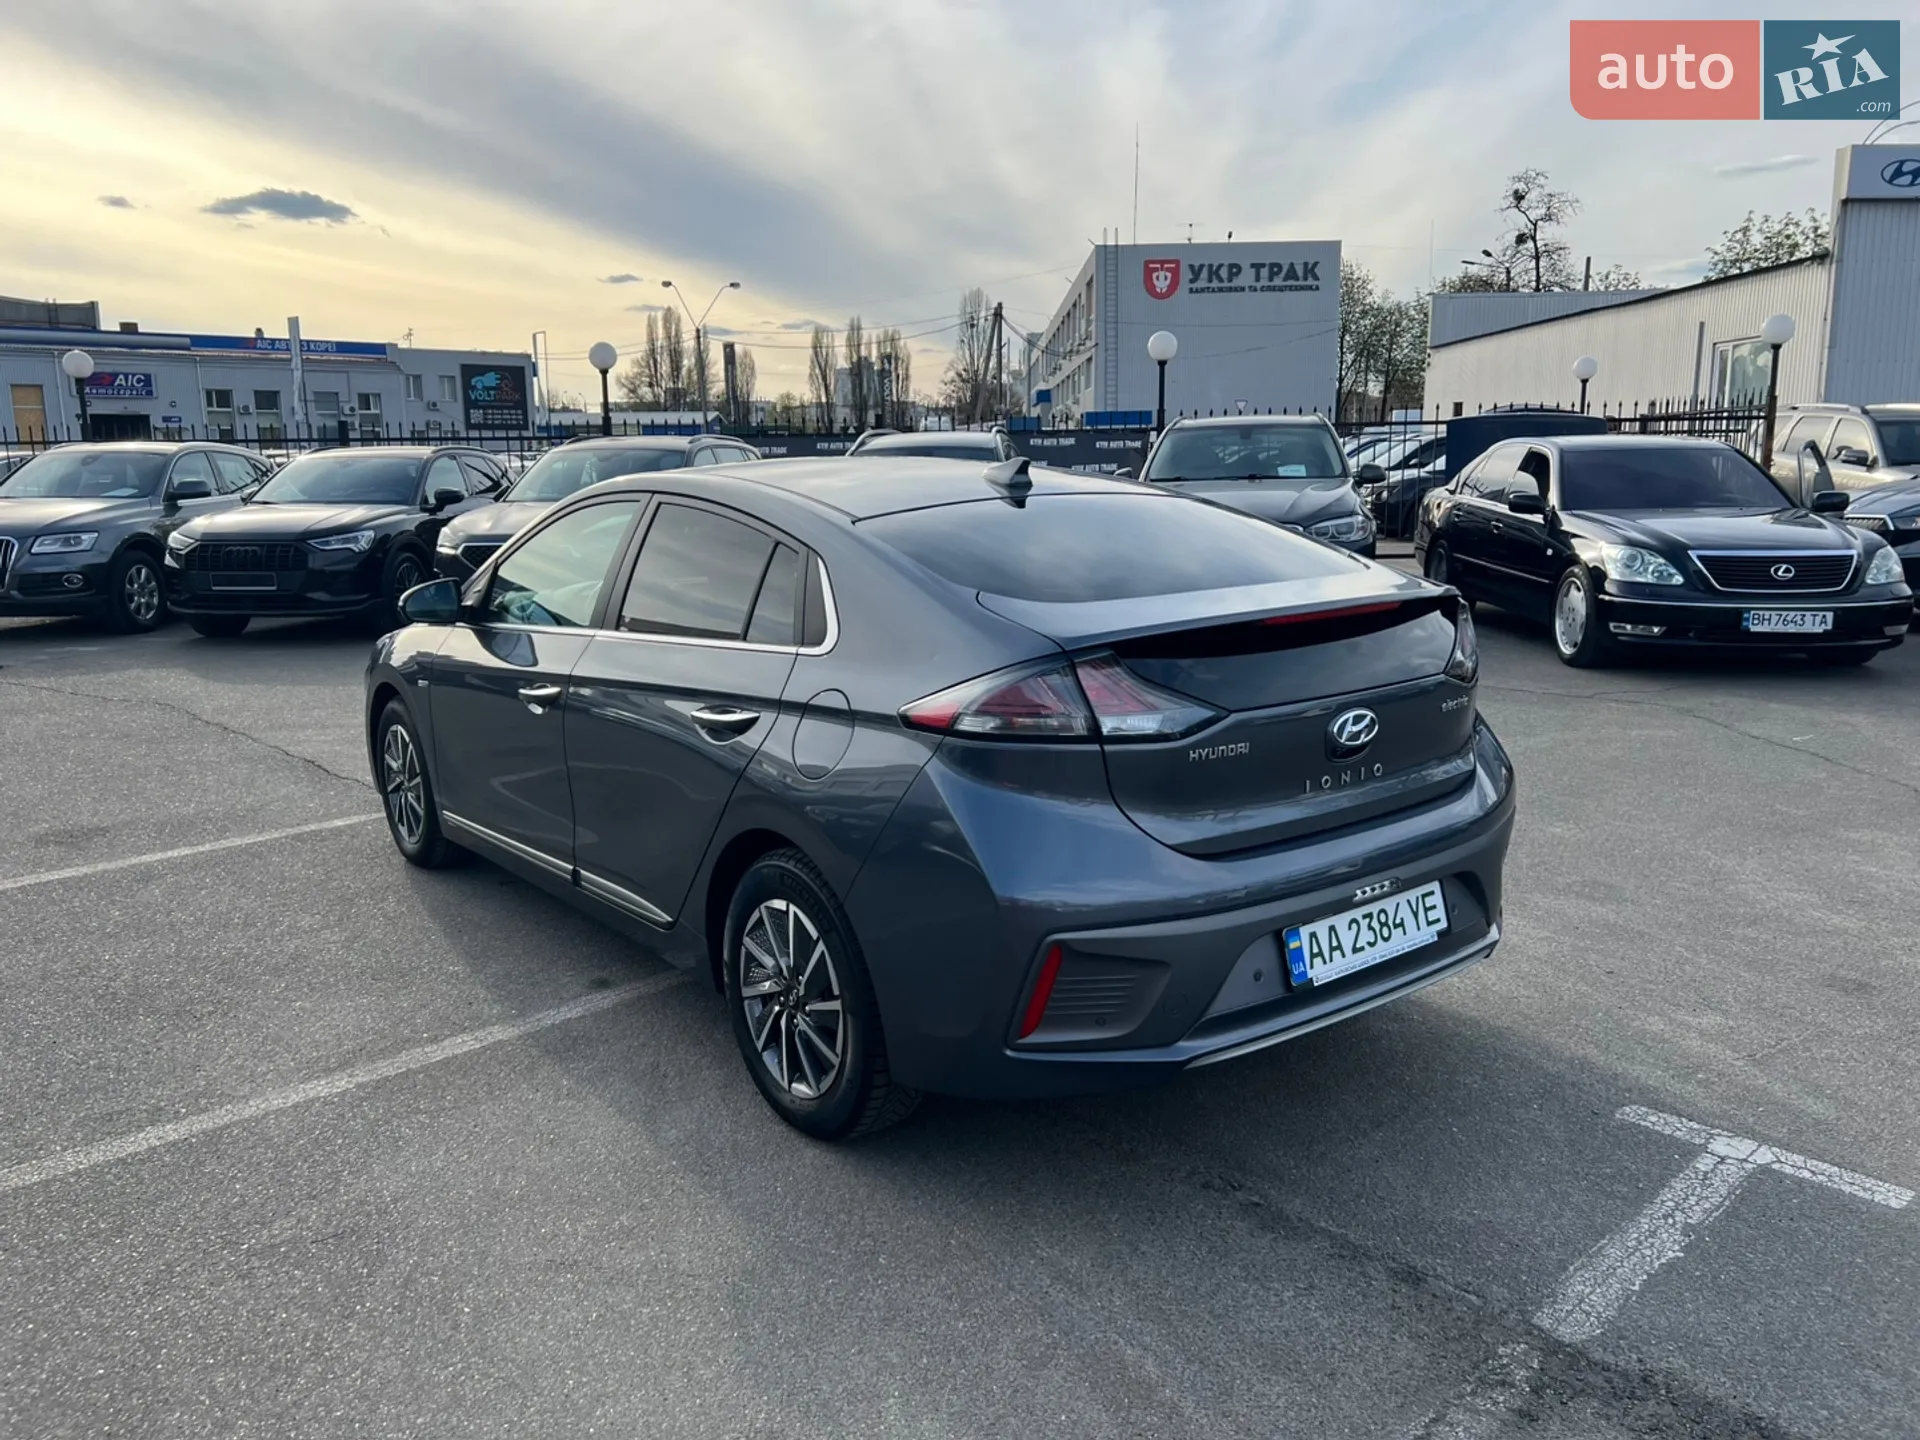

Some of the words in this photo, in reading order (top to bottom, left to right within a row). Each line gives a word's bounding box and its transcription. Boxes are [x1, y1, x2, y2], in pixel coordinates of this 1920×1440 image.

[1188, 262, 1243, 284] УКР
[1249, 261, 1321, 283] ТРАК
[274, 341, 291, 349] АВТ
[1751, 613, 1772, 627] BH
[1774, 613, 1806, 627] 7643
[1810, 613, 1828, 627] TA
[1188, 742, 1250, 762] HYUNDAI
[1304, 762, 1384, 793] IONIQ
[1308, 924, 1347, 970] AA
[1348, 902, 1407, 955] 2384
[1407, 890, 1441, 932] YE
[1292, 960, 1307, 975] UA
